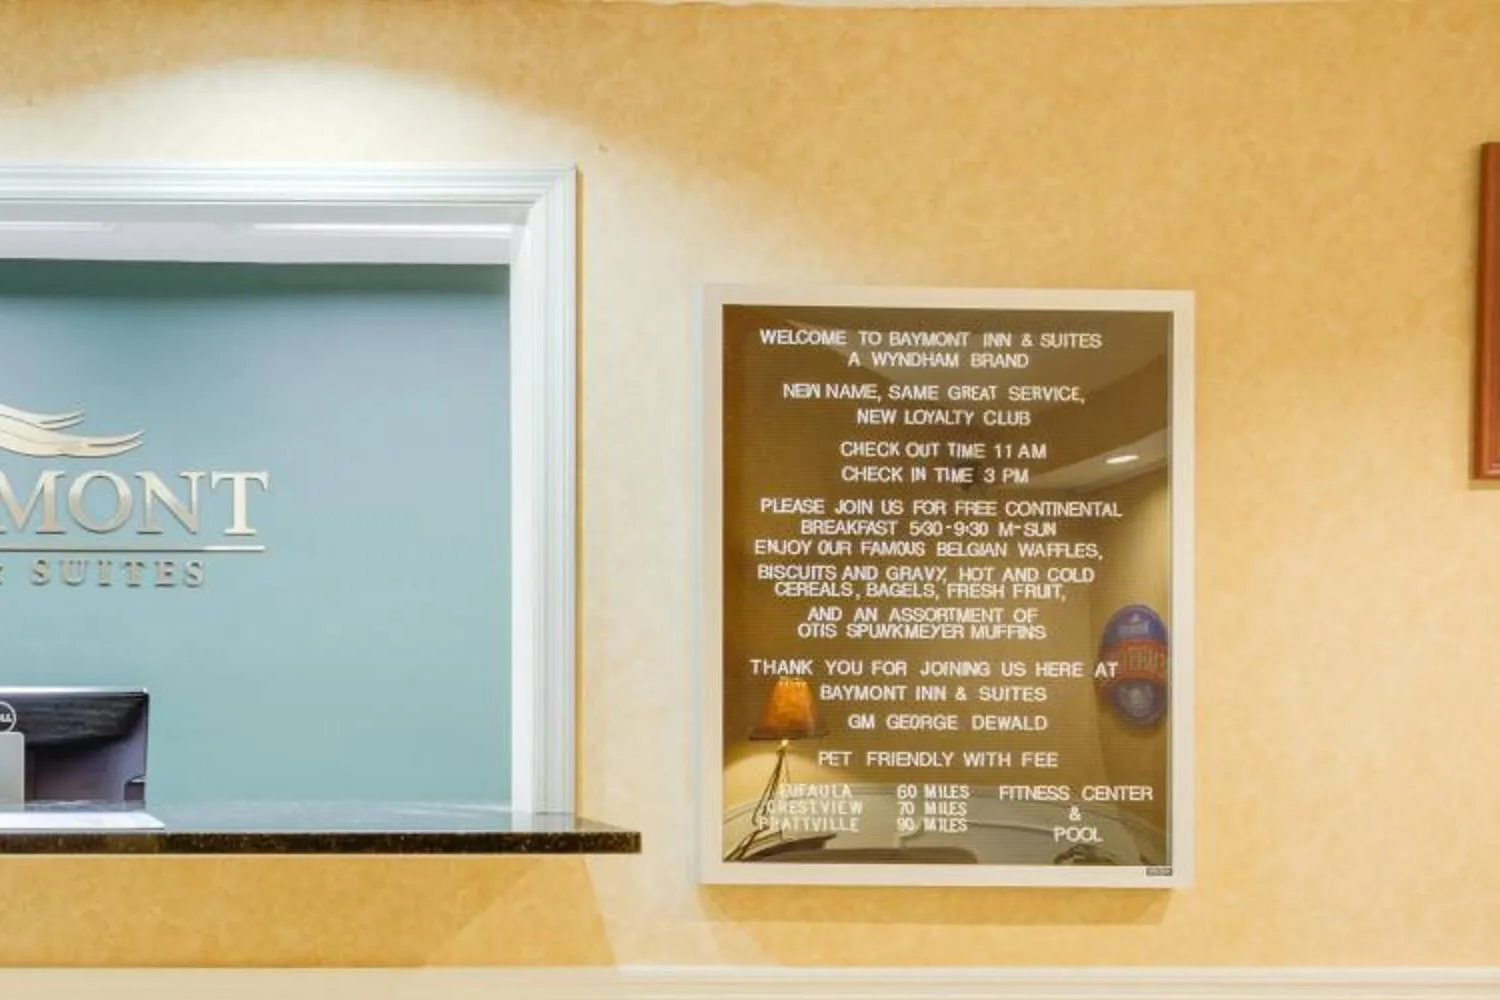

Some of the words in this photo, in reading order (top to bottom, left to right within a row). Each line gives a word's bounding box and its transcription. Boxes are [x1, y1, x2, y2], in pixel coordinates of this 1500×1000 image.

[759, 329, 846, 345] WELCOME
[858, 331, 881, 346] TO
[889, 331, 968, 347] BAYMONT
[983, 333, 1011, 347] INN
[1021, 333, 1032, 347] &
[1040, 333, 1102, 349] SUITES
[848, 353, 861, 367] A
[872, 352, 959, 368] WYNDHAM
[971, 353, 1029, 368] BRAND
[783, 383, 822, 399] NEW
[826, 384, 881, 402] NAME,
[888, 385, 938, 401] SAME
[948, 385, 997, 401] GREAT
[1008, 385, 1085, 404] SERVICE,
[857, 409, 896, 425] NEW
[904, 410, 974, 426] LOYALTY
[983, 410, 1031, 426] CLUB
[839, 442, 899, 458] CHECK
[905, 442, 939, 458] OUT
[948, 443, 986, 459] TIME
[995, 443, 1012, 459] 11
[1017, 444, 1047, 459] AM
[841, 466, 902, 482] CHECK
[911, 467, 926, 481] IN
[935, 467, 973, 483] TIME
[984, 468, 995, 484] 3
[1004, 468, 1029, 484] PM
[761, 498, 825, 514] PLEASE
[834, 499, 873, 515] JOIN
[881, 499, 903, 515] US
[914, 500, 946, 516] FOR
[955, 500, 998, 516] FREE
[1005, 501, 1123, 518] CONTINENTAL
[801, 520, 896, 536] BREAKFAST
[755, 540, 812, 556] ENJOY
[818, 541, 851, 556] OUR
[861, 540, 925, 557] FAMOUS
[938, 541, 1007, 556] BELGIAN
[1018, 542, 1103, 560] WAFFLES,
[30, 558, 206, 588] SUITES
[757, 565, 837, 581] BISCUITS
[842, 566, 879, 582] AND
[885, 567, 947, 585] GRAVY,
[959, 567, 993, 582] HOT
[1004, 567, 1038, 583] AND
[1047, 567, 1094, 583] COLD
[867, 583, 939, 600] BAGELS,
[947, 584, 1008, 599] FRESH
[1014, 584, 1066, 601] FRUIT,
[807, 608, 842, 621] AND
[853, 608, 877, 622] AN
[889, 608, 1002, 623] ASSORTMENT
[1013, 609, 1038, 623] OF
[798, 624, 837, 638] OTIS
[971, 625, 1047, 640] MUFFINS
[750, 660, 813, 675] THANK
[825, 660, 863, 675] YOU
[871, 661, 907, 676] FOR
[920, 661, 990, 676] JOINING
[1001, 661, 1025, 677] US
[1036, 662, 1083, 677] HERE
[1094, 661, 1118, 678] AT
[819, 686, 907, 700] BAYMONT
[916, 686, 944, 700] INN
[955, 687, 967, 700] &
[979, 687, 1047, 701] SUITES
[848, 715, 874, 730] GM
[886, 715, 958, 730] GEORGE
[972, 716, 1047, 730] DEWALD
[818, 752, 852, 766] PET
[867, 752, 954, 767] FRIENDLY
[963, 752, 1011, 767] WITH
[1021, 753, 1058, 767] FEE
[897, 784, 917, 799] 60
[923, 785, 970, 800] MILES
[999, 786, 1070, 801] FITNESS
[1081, 786, 1153, 801] CENTER
[897, 801, 914, 816] 70
[923, 801, 968, 816] MILES
[1069, 807, 1080, 821] &
[923, 818, 968, 832] MILES
[1054, 827, 1102, 842] POOL
